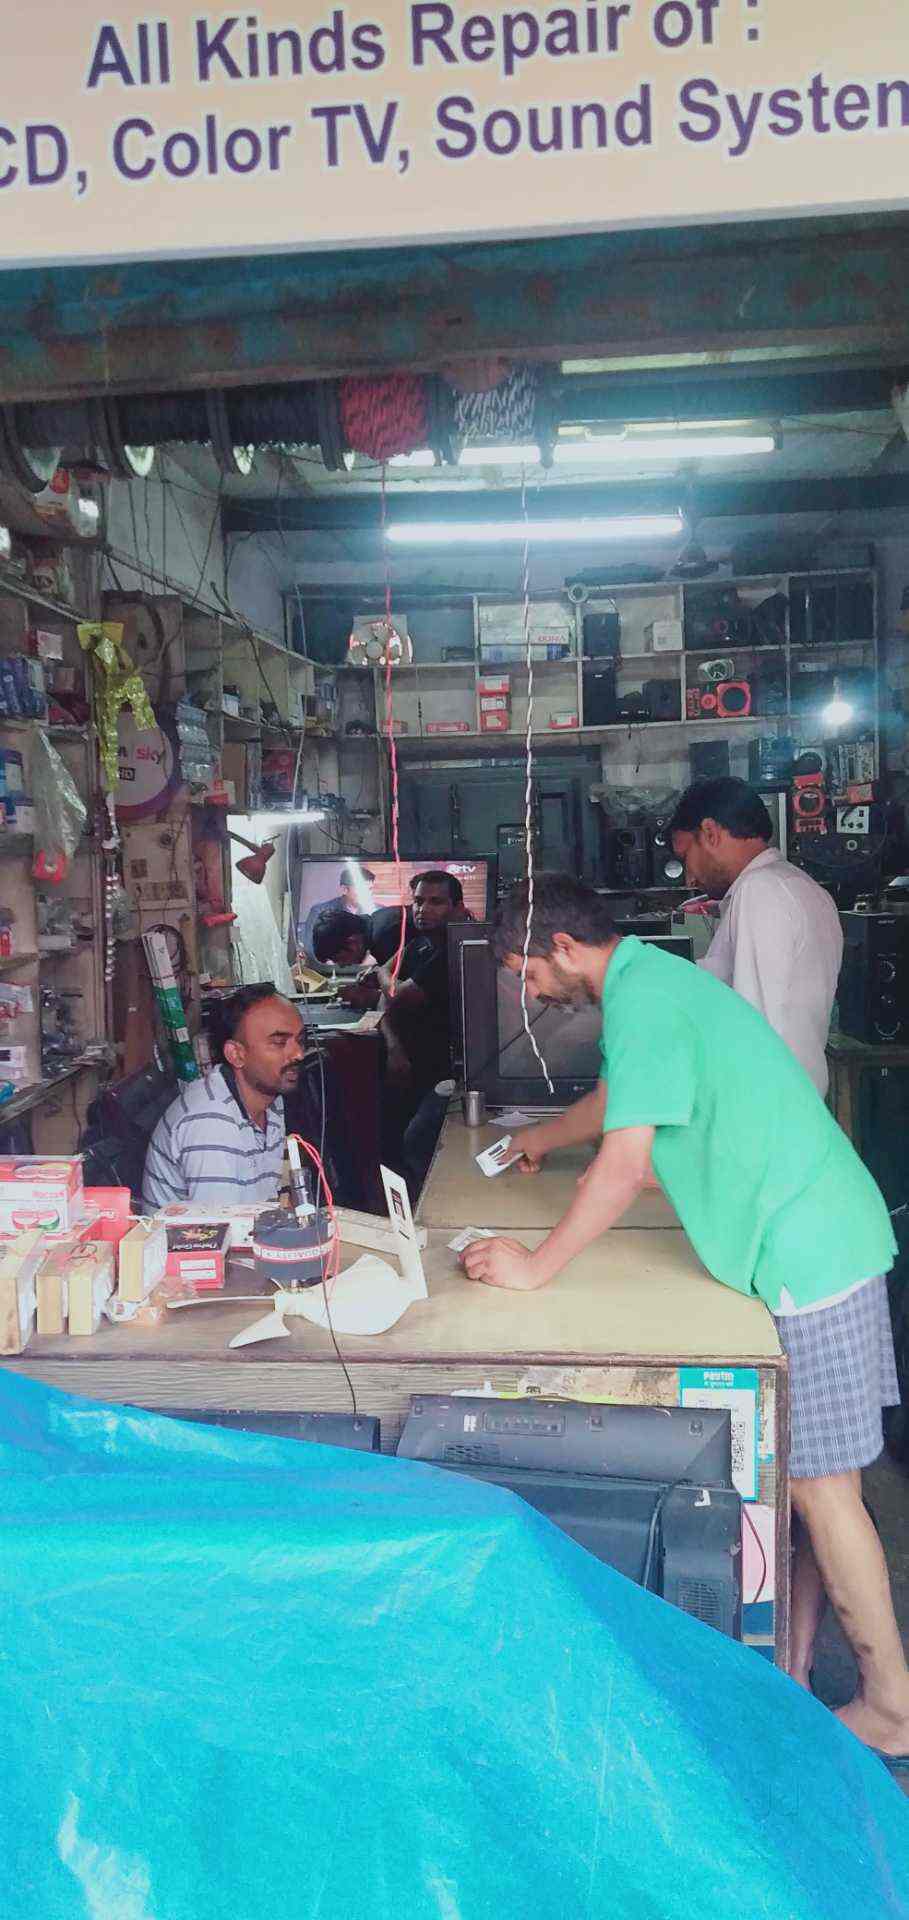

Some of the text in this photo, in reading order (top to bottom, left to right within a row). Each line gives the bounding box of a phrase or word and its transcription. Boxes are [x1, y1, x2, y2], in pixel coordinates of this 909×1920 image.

[88, 22, 170, 88] All
[196, 10, 386, 82] Kinds
[411, 0, 631, 76] Repair
[654, 0, 719, 49] of
[113, 114, 291, 180] Color
[312, 101, 409, 174] TV,
[436, 83, 652, 159] Sound
